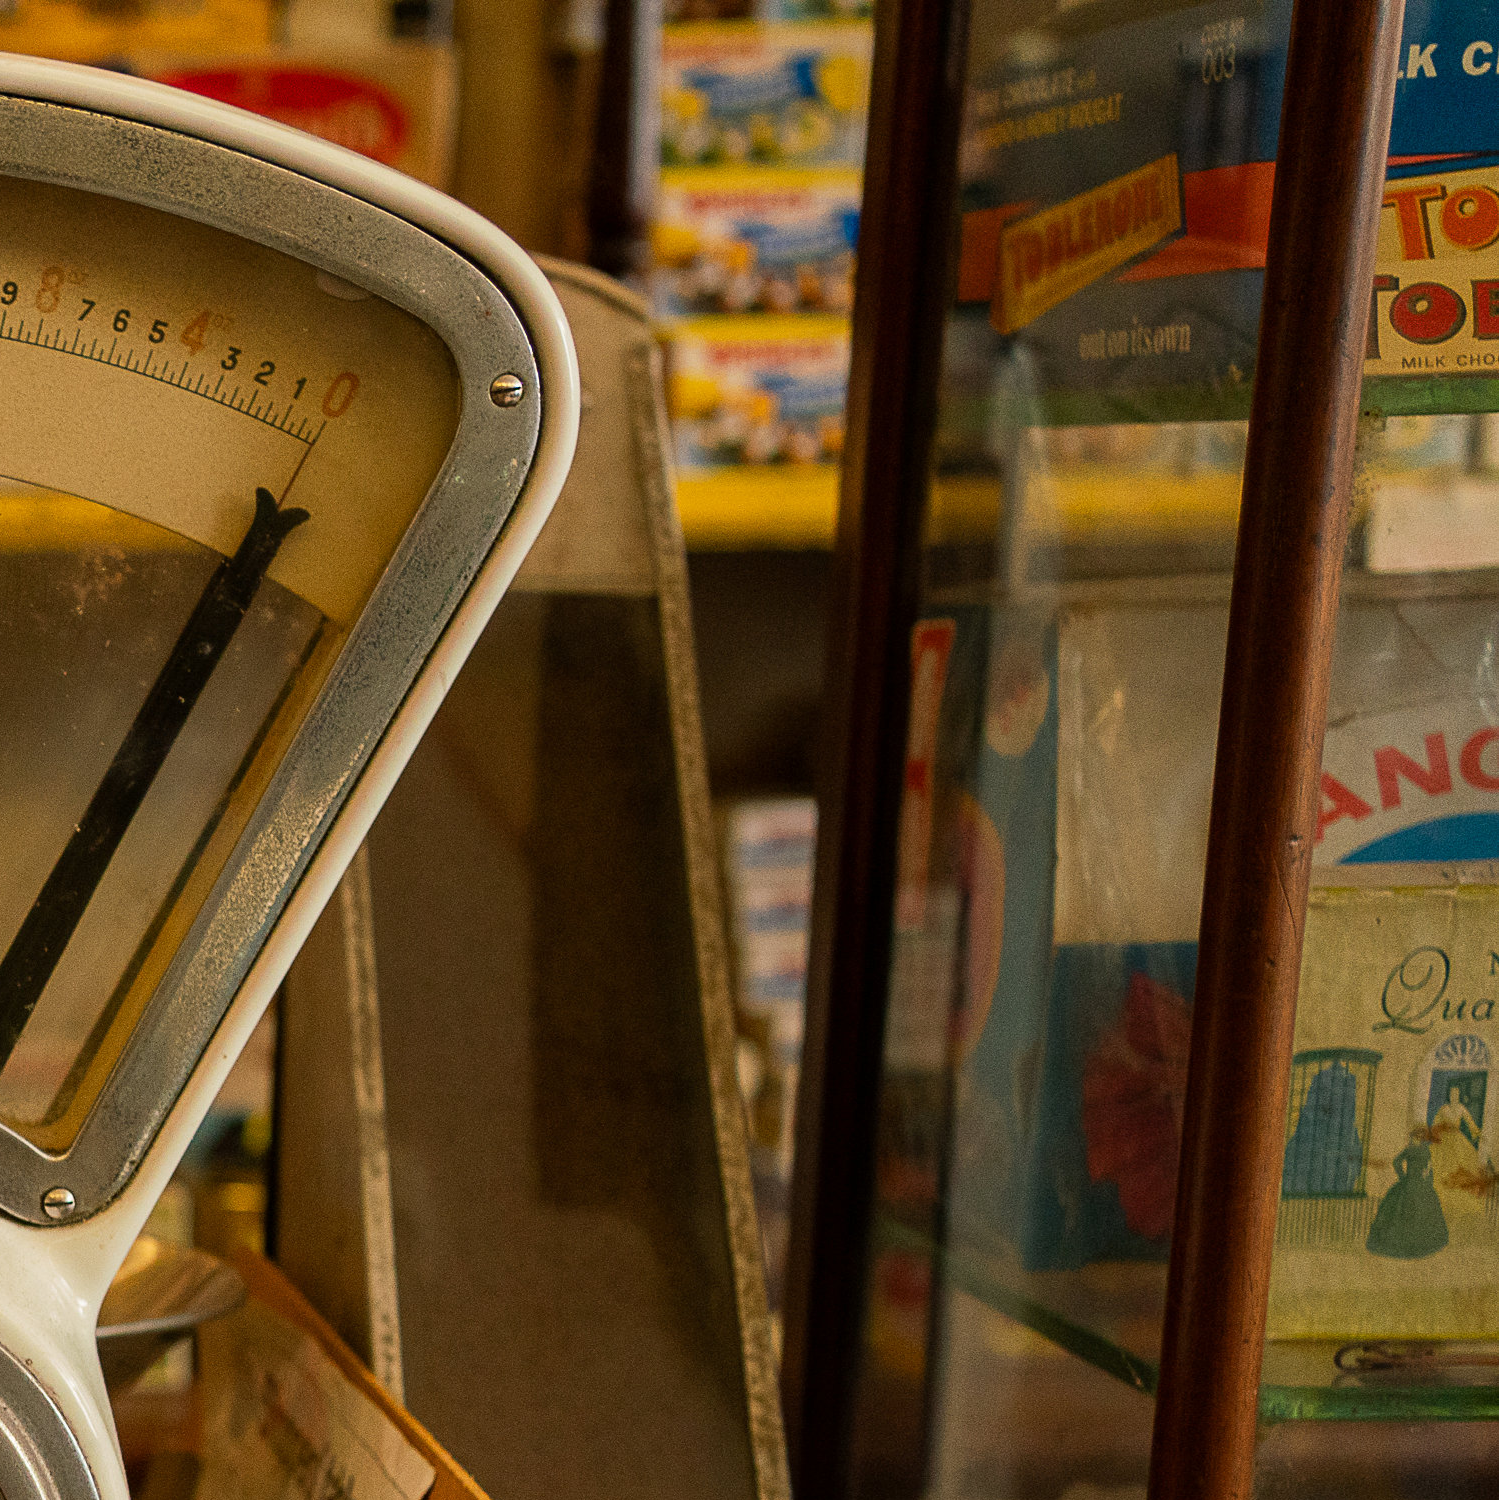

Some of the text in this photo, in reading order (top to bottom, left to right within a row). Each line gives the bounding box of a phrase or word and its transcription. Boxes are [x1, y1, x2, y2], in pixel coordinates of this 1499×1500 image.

[1461, 40, 1499, 77] C
[1008, 170, 1169, 296] TOBLERONE
[1, 281, 19, 306] 9
[35, 266, 65, 314] 8
[78, 299, 96, 323] 7
[112, 309, 132, 333] 6
[148, 320, 169, 345] 5
[180, 309, 211, 356] 4
[220, 345, 244, 372] 3
[253, 360, 277, 387] 2
[291, 376, 309, 401] 1
[321, 371, 360, 419] 0
[1400, 354, 1447, 371] MILK
